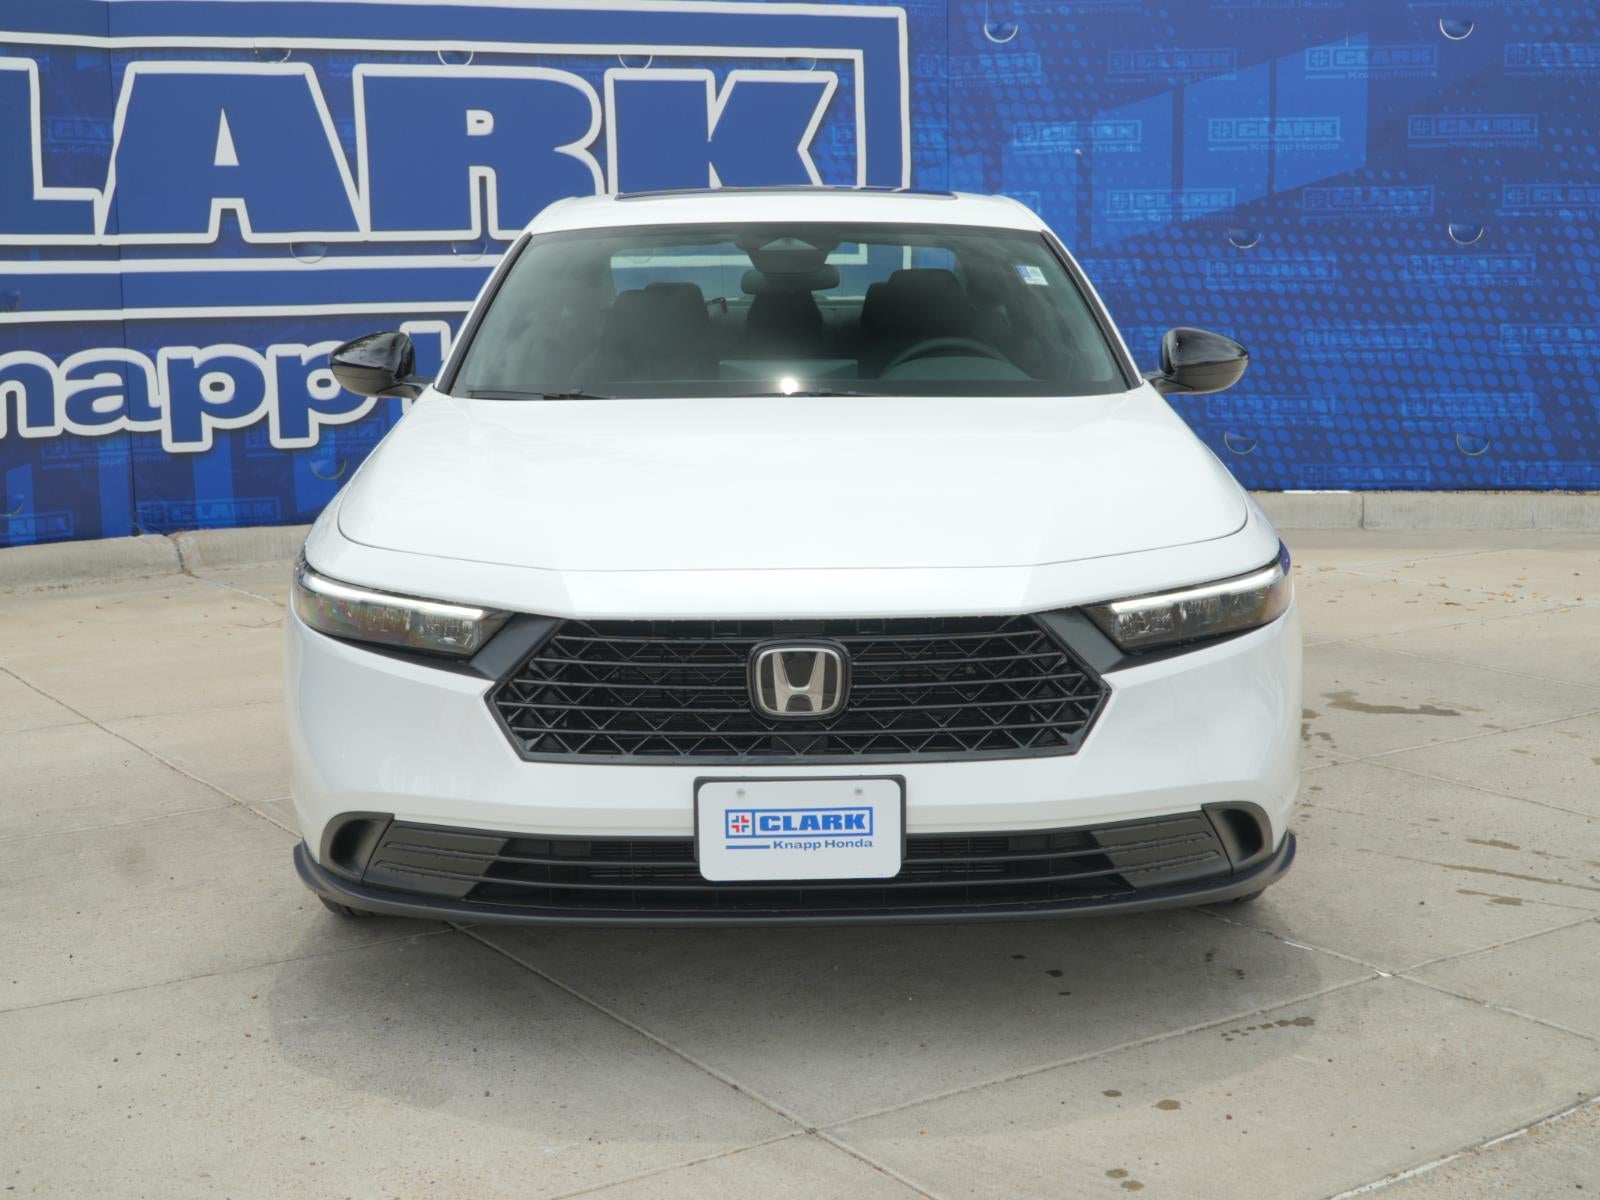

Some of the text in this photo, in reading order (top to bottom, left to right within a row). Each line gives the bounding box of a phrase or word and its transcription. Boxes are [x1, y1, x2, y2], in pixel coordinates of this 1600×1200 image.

[1238, 122, 1333, 137] CLARK
[759, 813, 866, 832] CLARK
[773, 838, 873, 851] Knapp Honda
